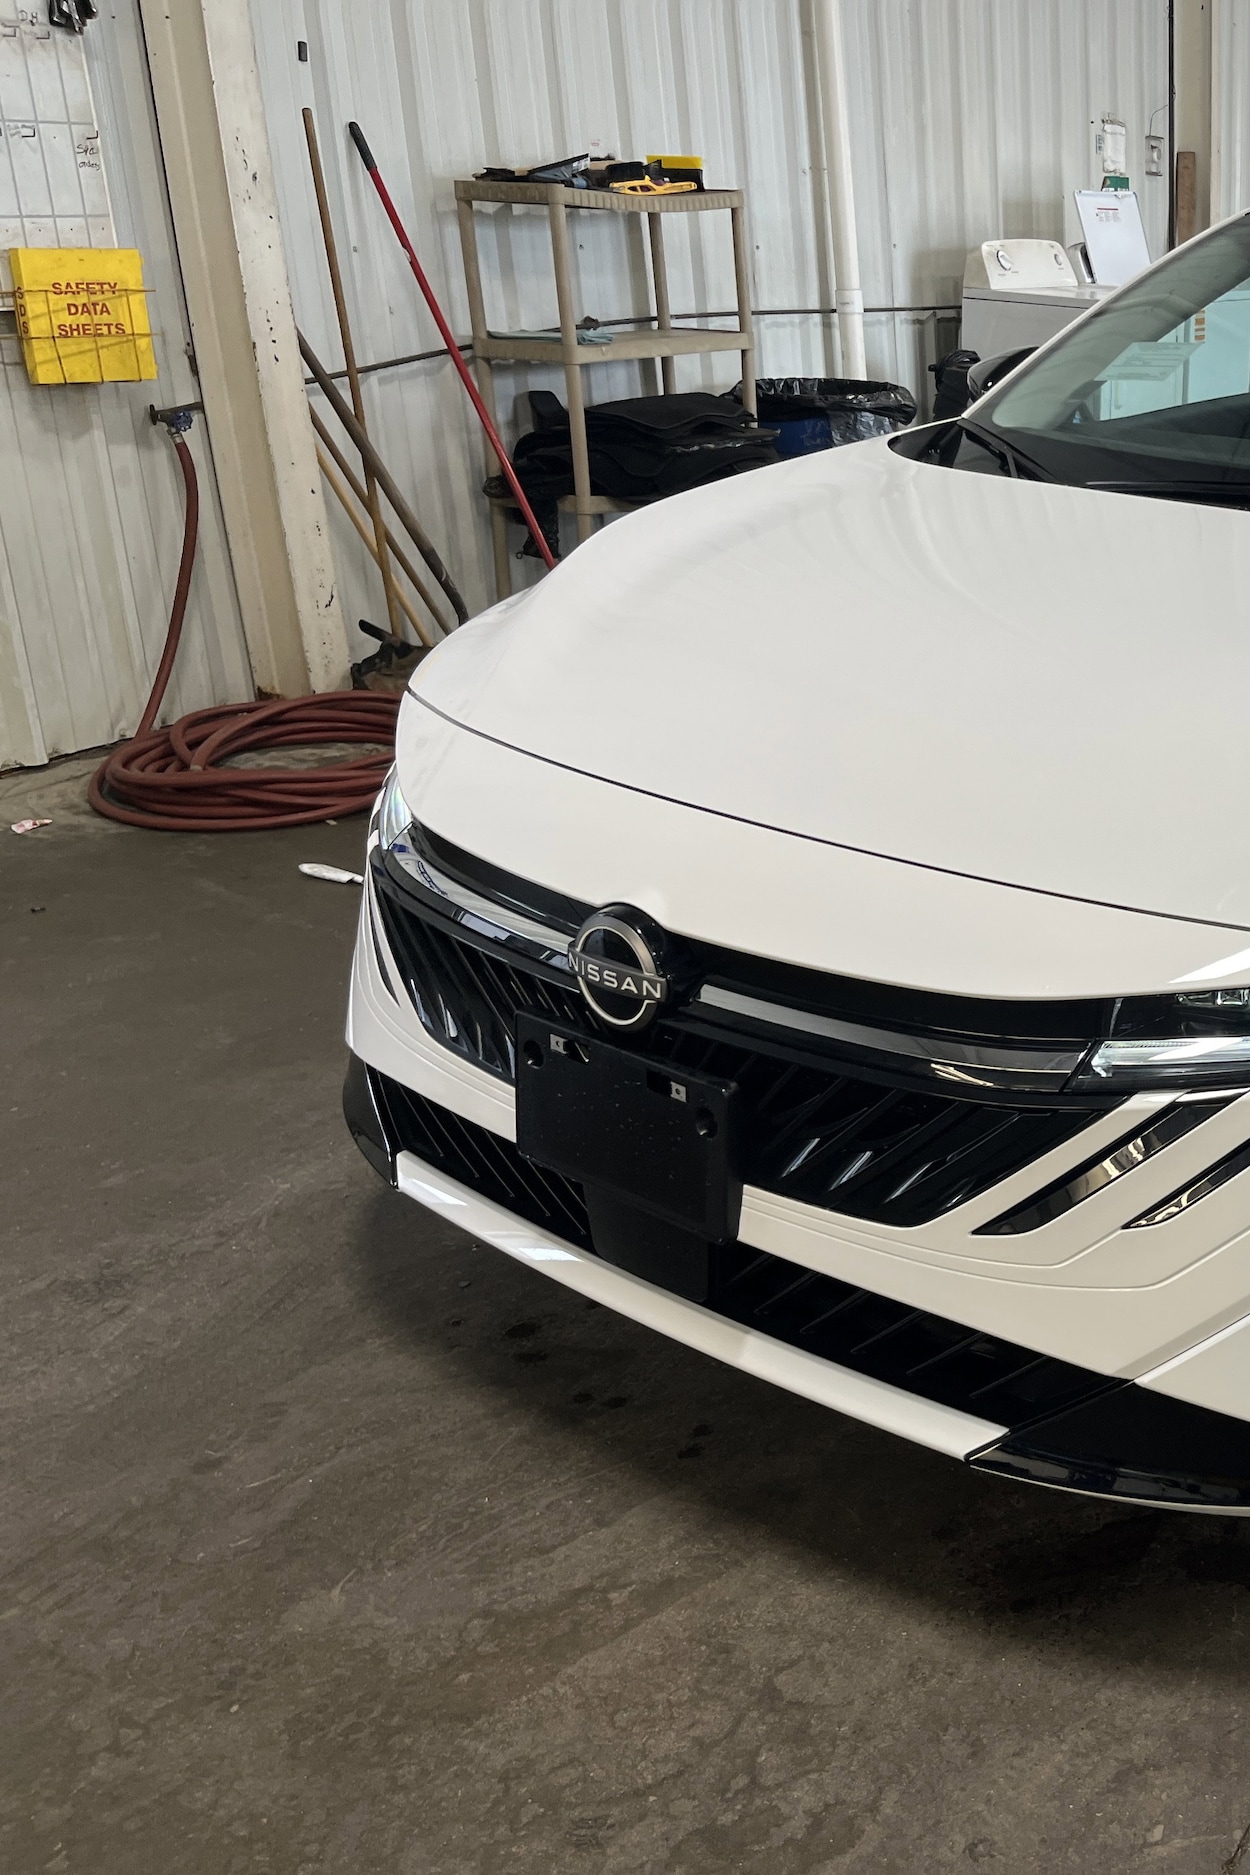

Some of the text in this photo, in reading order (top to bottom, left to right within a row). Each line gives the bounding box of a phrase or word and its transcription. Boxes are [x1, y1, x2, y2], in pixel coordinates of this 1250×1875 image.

[52, 282, 117, 295] SAFETY
[66, 302, 111, 316] DATA
[57, 323, 126, 338] SHEETS
[568, 951, 661, 999] NISSAN
